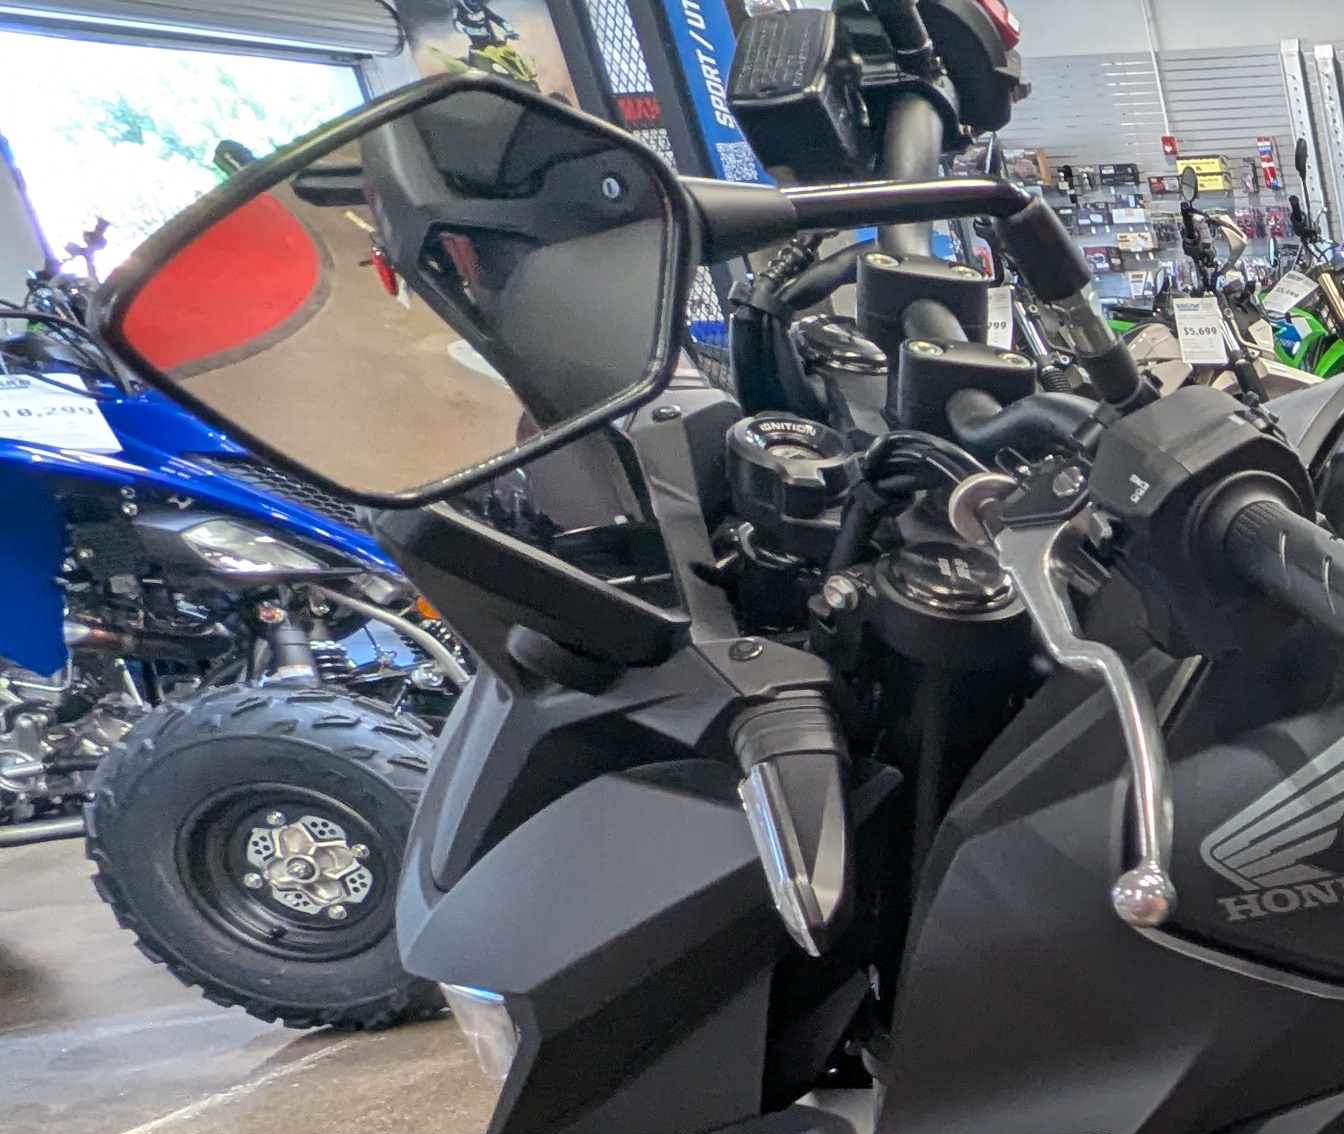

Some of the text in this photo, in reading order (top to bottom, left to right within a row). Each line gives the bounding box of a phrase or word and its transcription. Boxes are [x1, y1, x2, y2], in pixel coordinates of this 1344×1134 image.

[696, 49, 735, 129] SPORT
[1184, 326, 1217, 338] $5,699
[759, 422, 817, 437] IGNITION
